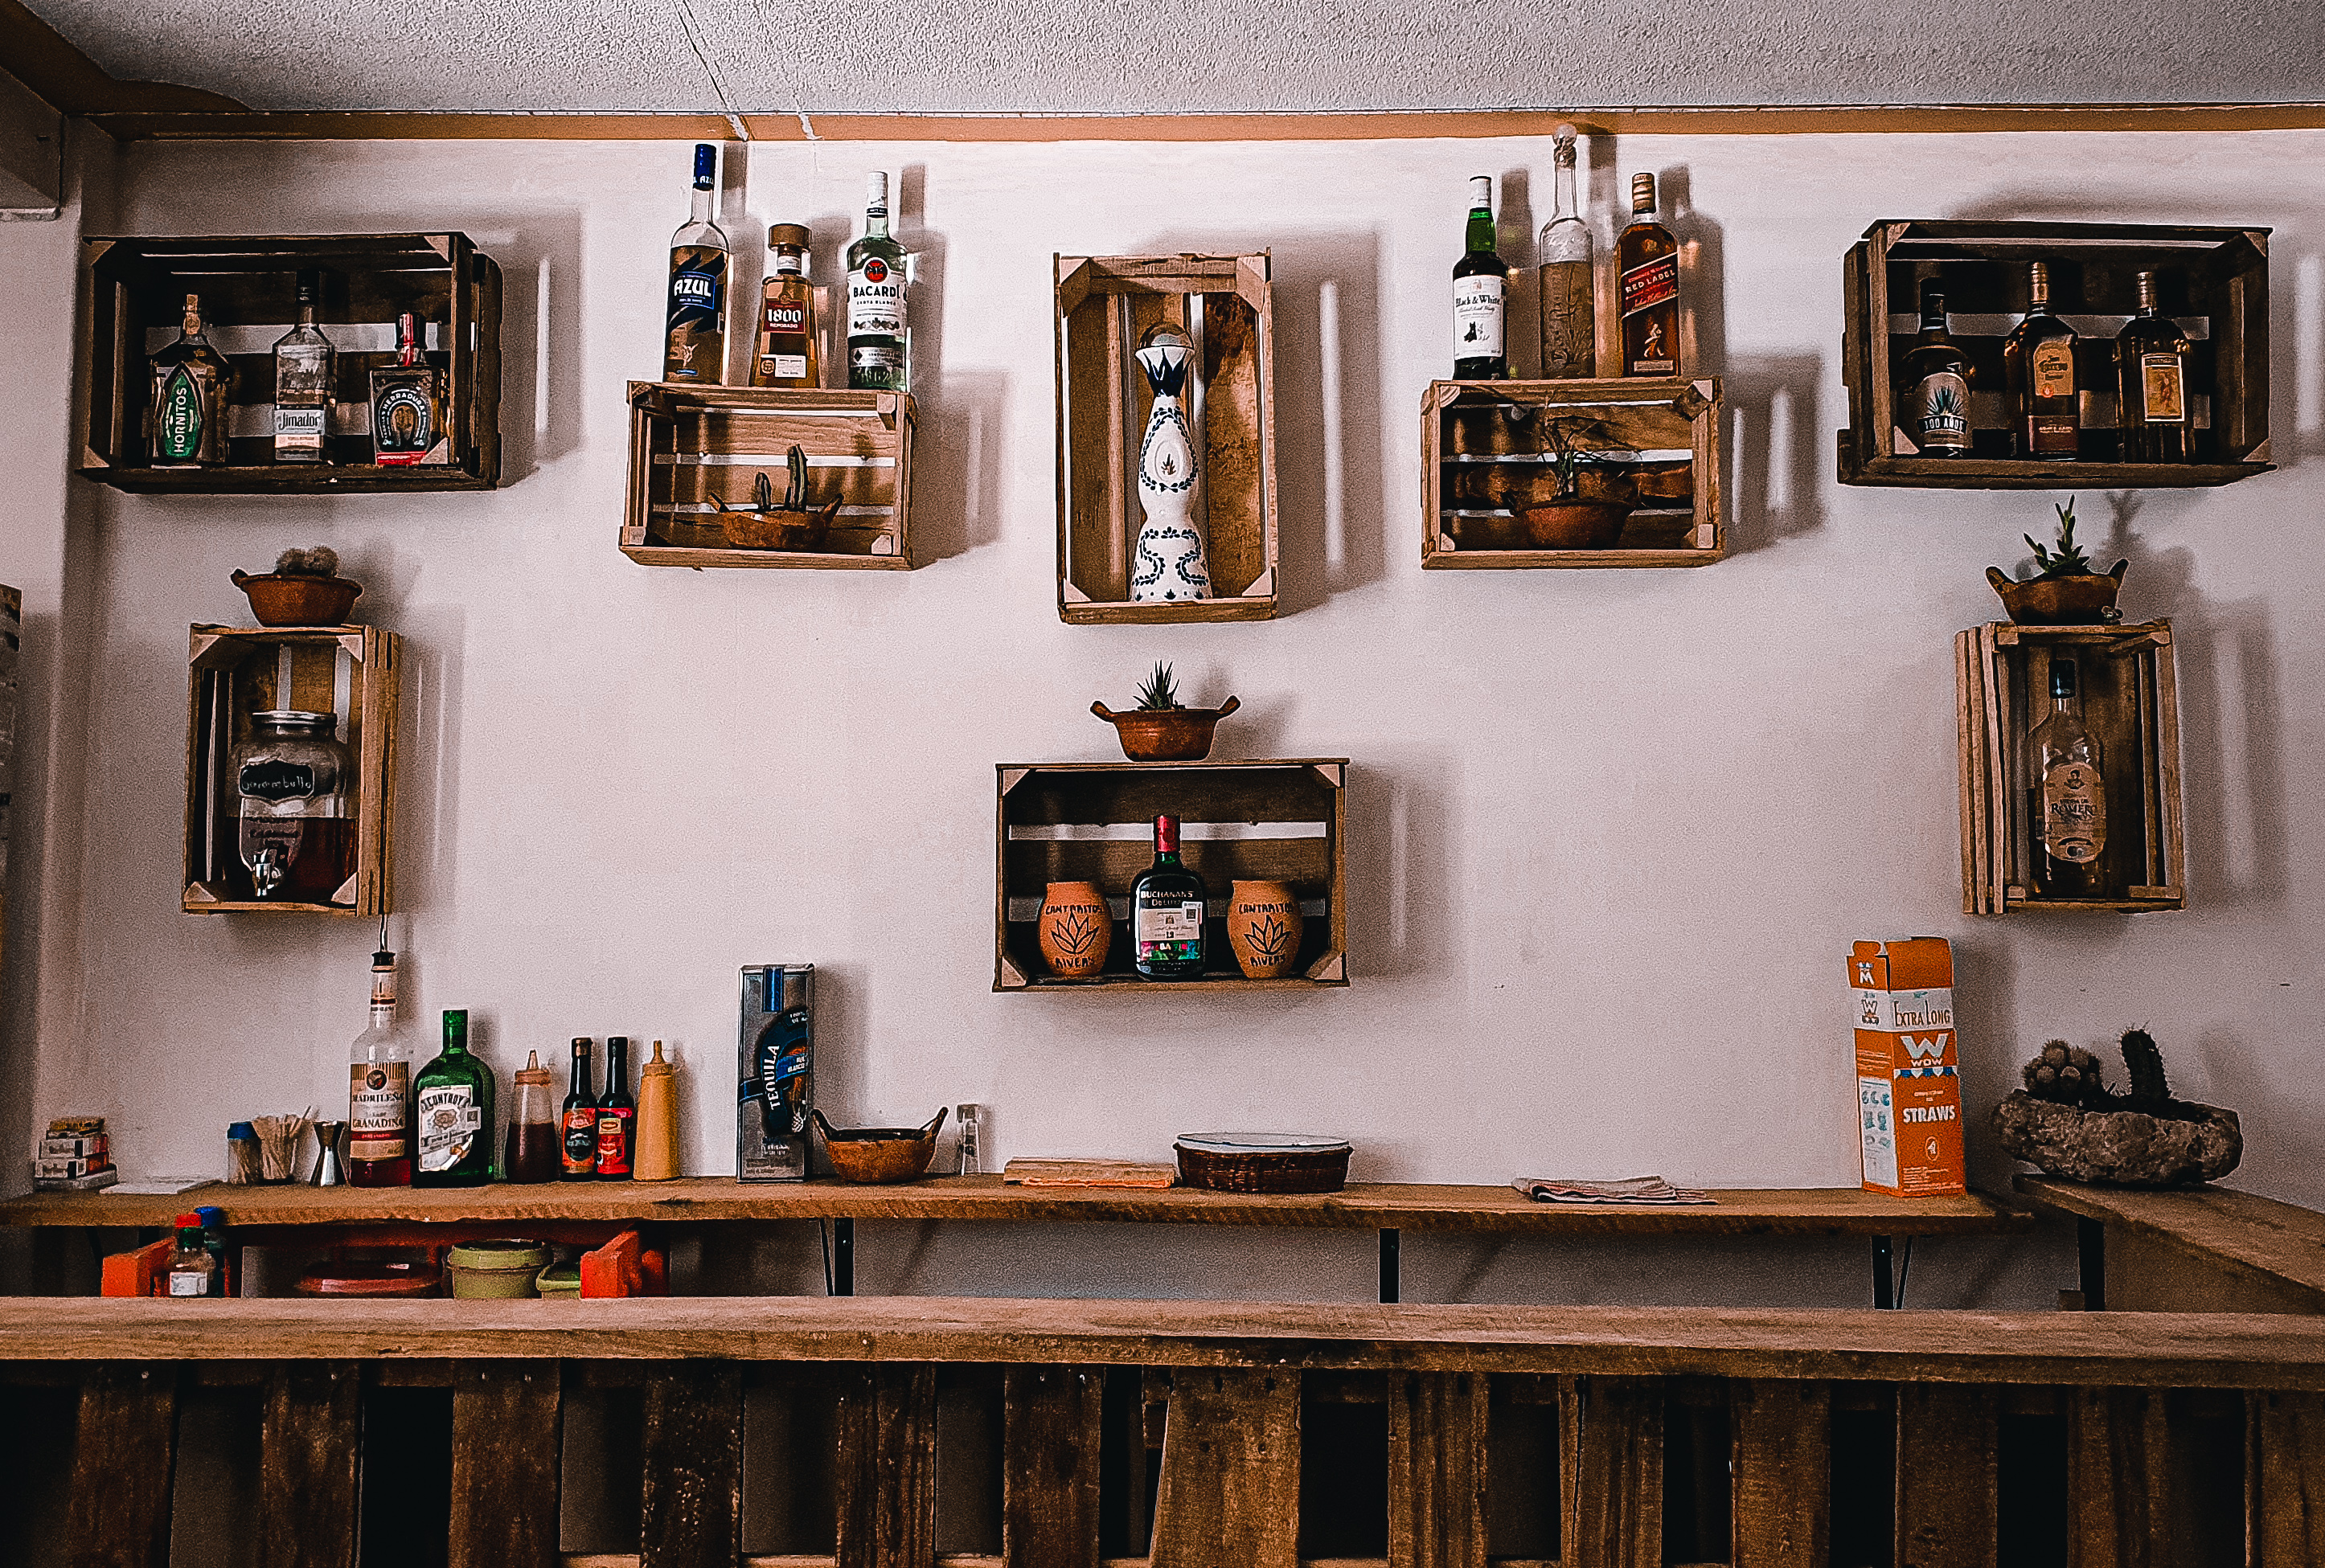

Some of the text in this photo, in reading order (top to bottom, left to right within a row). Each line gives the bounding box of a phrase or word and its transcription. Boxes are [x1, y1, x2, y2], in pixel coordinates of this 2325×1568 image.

[674, 278, 711, 297] AZUL
[1625, 280, 1645, 294] RED
[1646, 269, 1675, 285] LABEL
[768, 309, 802, 323] 1800
[383, 392, 426, 411] HERRADURA
[174, 387, 187, 452] HORNITOS
[1924, 417, 1941, 429] 100
[1899, 1033, 1949, 1059] W
[763, 1045, 780, 1110] TEQUILA
[426, 1092, 465, 1106] CONTROY
[1903, 1104, 1955, 1123] STRAWS
